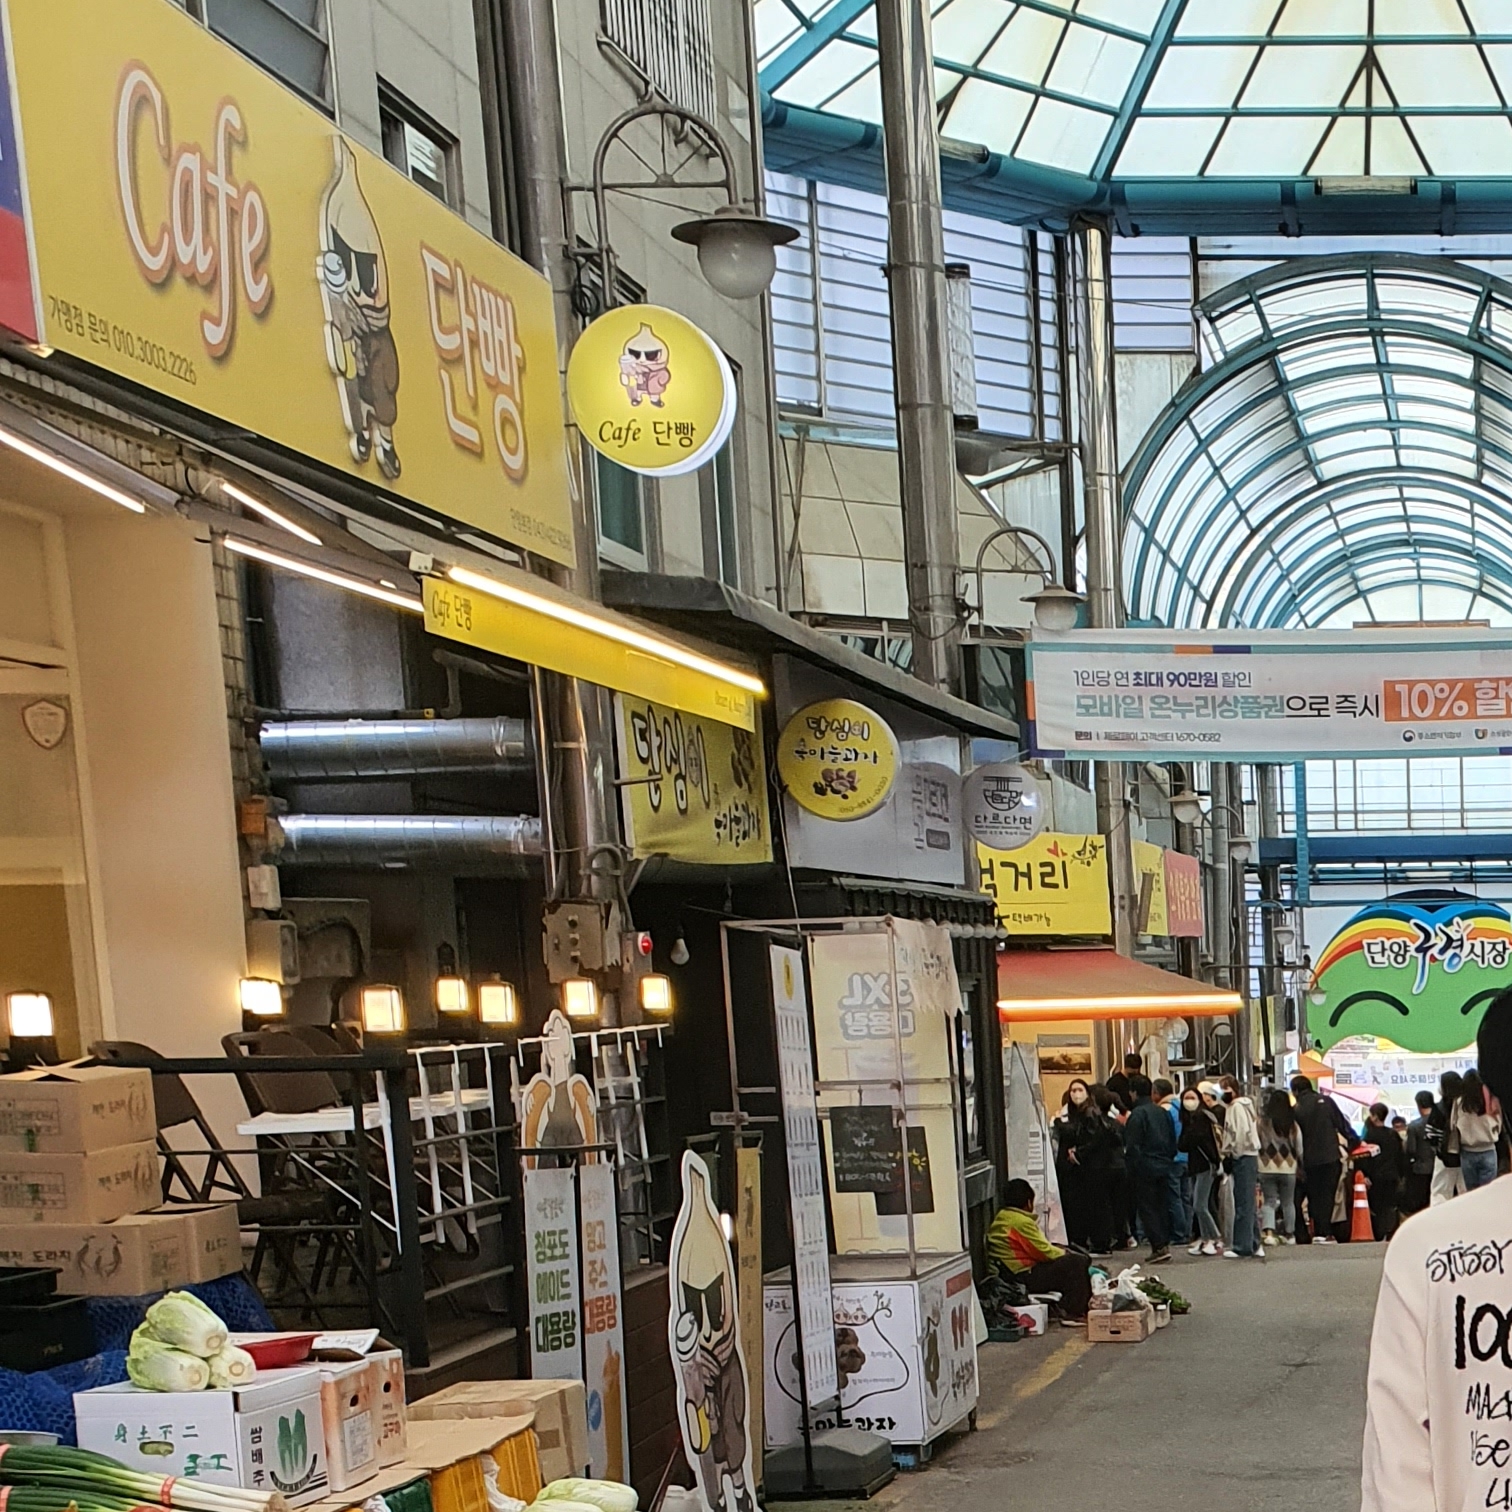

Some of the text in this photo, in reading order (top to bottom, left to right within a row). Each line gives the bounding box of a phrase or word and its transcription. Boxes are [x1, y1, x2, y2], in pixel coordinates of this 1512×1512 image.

[115, 59, 273, 358] Cafe
[49, 295, 197, 386] 가맹점 문의 010.3003.2226
[420, 242, 526, 480] 단빵
[598, 419, 697, 449] Cafe 단빵
[1073, 670, 1252, 688] 1인당 연 최대 90만원 할인
[1075, 694, 1144, 718] 모바일
[1149, 694, 1331, 719] 온누리상품권으로
[1334, 694, 1381, 719] 즉시
[1395, 682, 1467, 718] 10%
